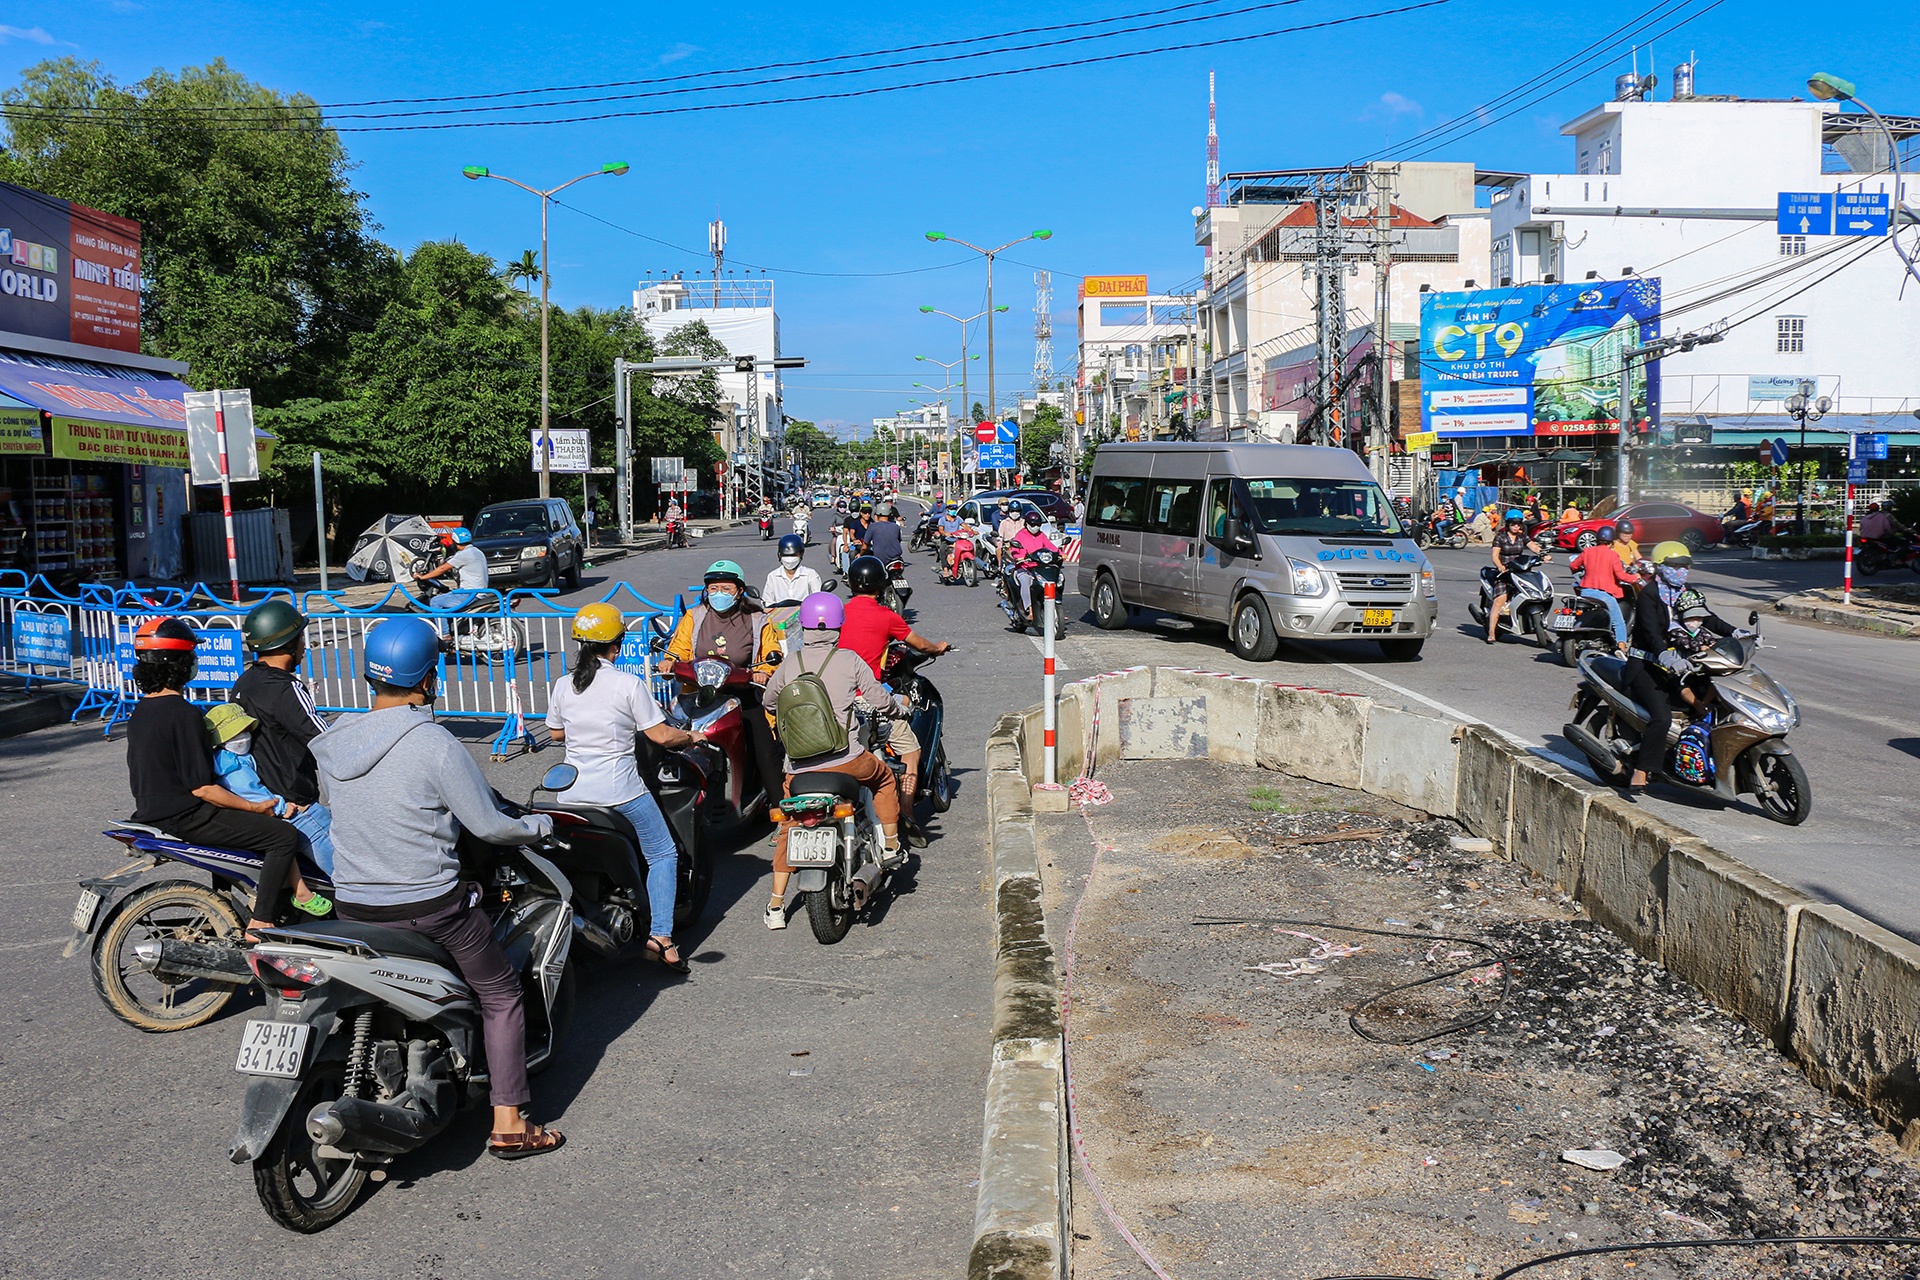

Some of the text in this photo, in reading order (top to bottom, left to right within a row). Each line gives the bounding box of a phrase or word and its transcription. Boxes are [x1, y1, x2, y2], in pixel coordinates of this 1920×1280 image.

[73, 259, 110, 285] MINH
[0, 269, 58, 303] ORLD
[1098, 277, 1144, 294] ĐẠI PHÁT
[1459, 311, 1497, 321] CĂN HỘ
[1433, 322, 1524, 361] CT9
[1474, 361, 1486, 369] ĐÔ
[1490, 361, 1505, 369] THỊ
[1453, 395, 1464, 403] 1%
[67, 424, 101, 438] TRUNG
[104, 426, 124, 441] TÂM
[127, 430, 138, 442] TƯ
[180, 436, 186, 447] &
[128, 445, 148, 456] BẢO
[1317, 548, 1417, 563] ĐỨC LỘC
[21, 620, 63, 635] KHU VỰC CẤM
[213, 634, 232, 650] CẤM
[220, 655, 235, 667] TIỆN
[369, 661, 384, 671] BIDV
[187, 847, 247, 862] EXCITER
[369, 969, 434, 985] AIR BLADE
[252, 1023, 298, 1048] 79-H1
[240, 1047, 298, 1073] 341.49
